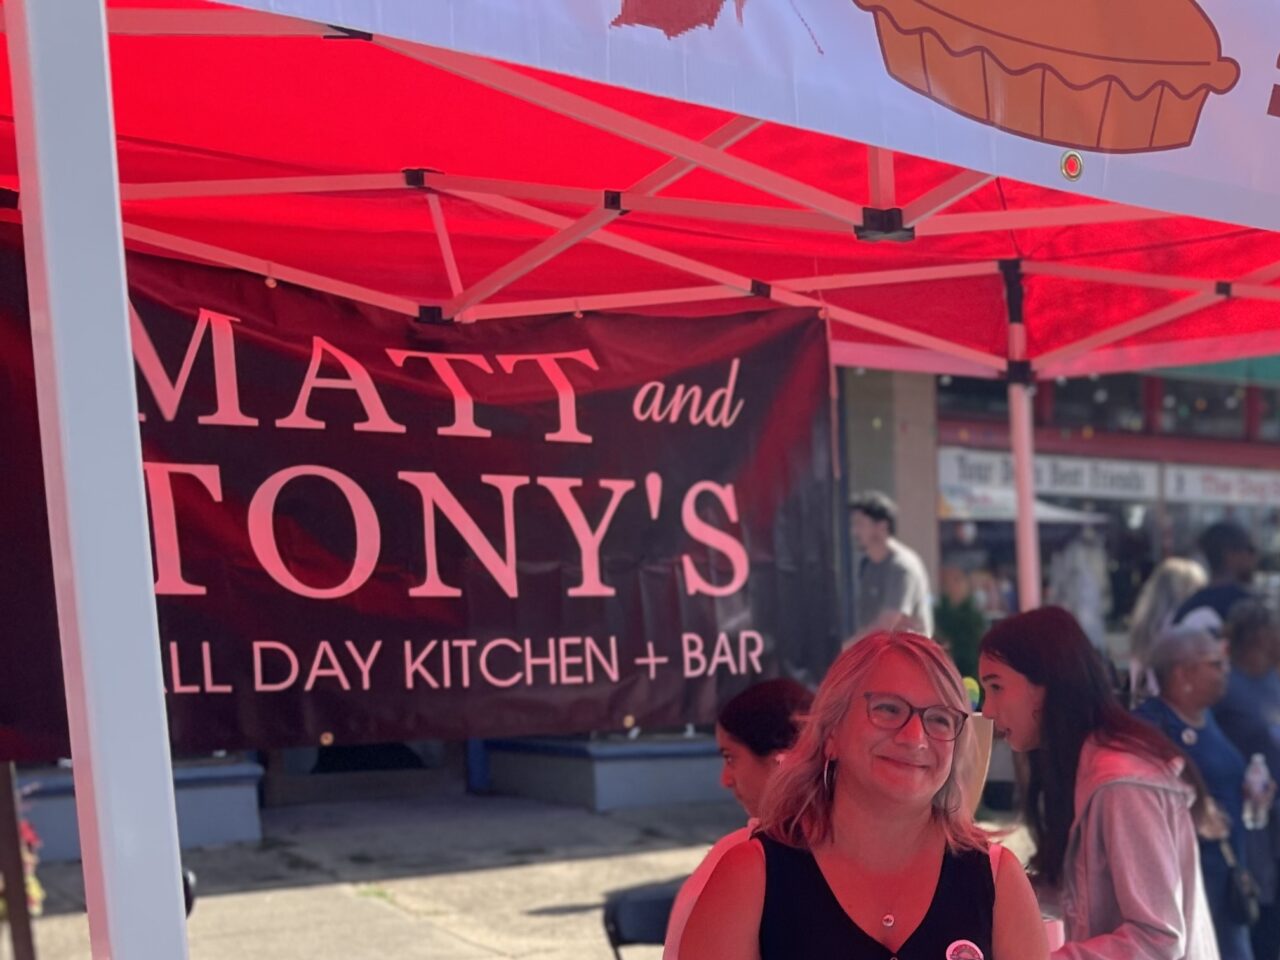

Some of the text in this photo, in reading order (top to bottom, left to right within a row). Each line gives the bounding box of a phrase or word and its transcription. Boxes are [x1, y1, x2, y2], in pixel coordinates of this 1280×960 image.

[128, 299, 745, 444] MATT and
[143, 461, 750, 599] TONY'S
[162, 630, 765, 694] LL DAY KITCHEN + BAR
